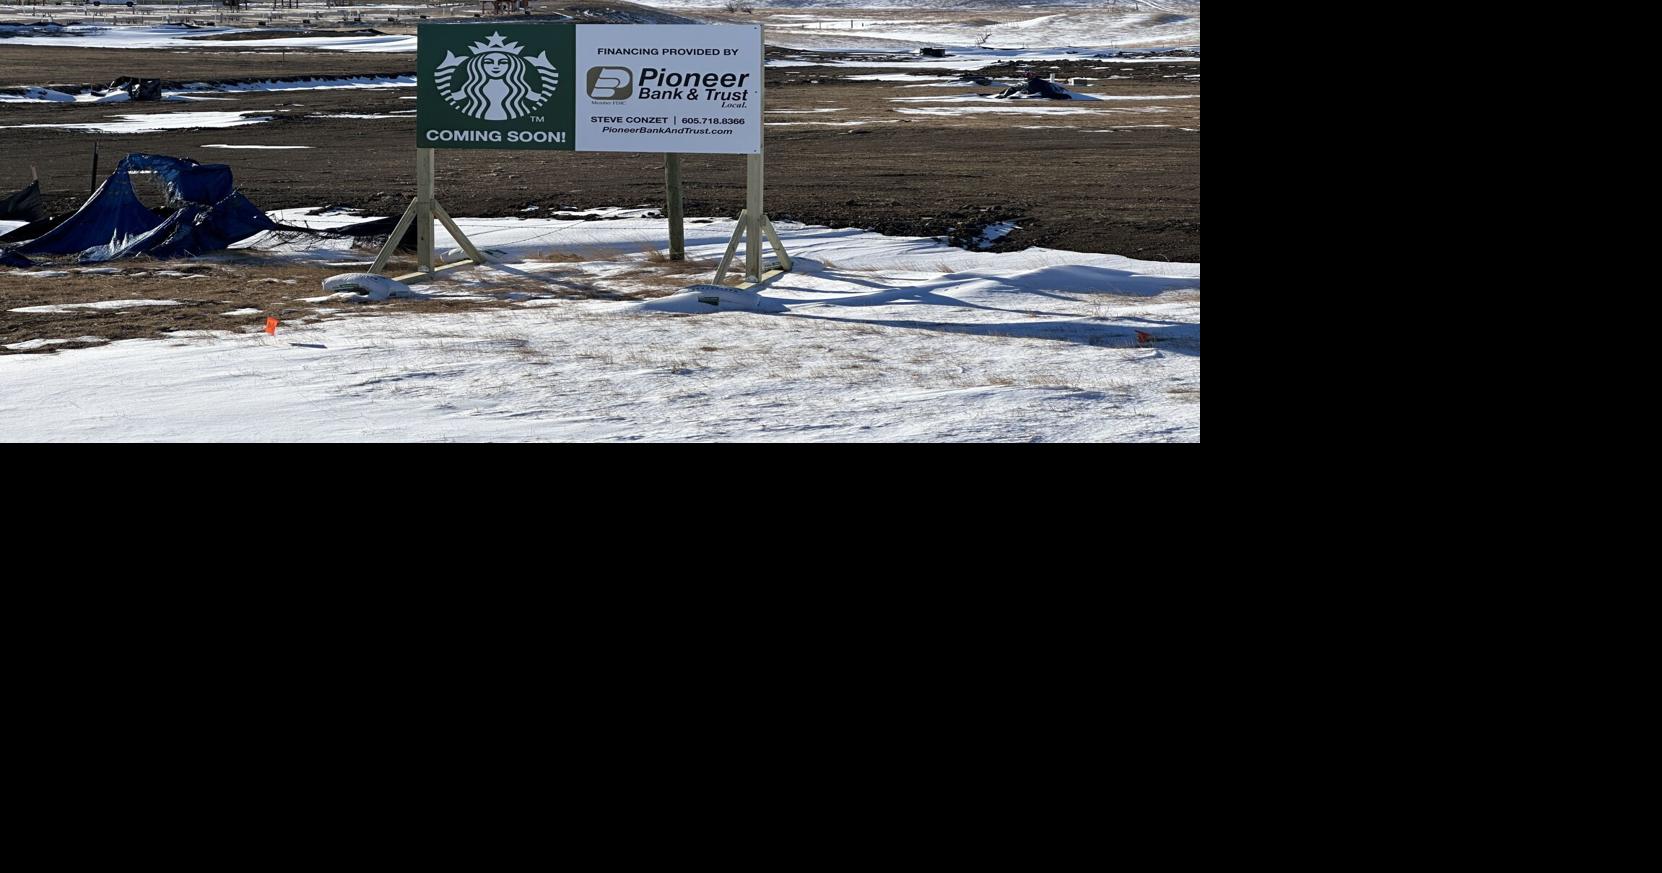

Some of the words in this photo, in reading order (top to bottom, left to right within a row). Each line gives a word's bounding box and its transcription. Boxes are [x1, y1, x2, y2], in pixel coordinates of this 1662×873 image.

[597, 47, 659, 56] FINANCING
[662, 48, 720, 56] PROVIDED
[723, 48, 739, 56] BY
[638, 67, 750, 88] Pioneer
[638, 87, 683, 100] Bank
[686, 88, 699, 101] &
[705, 88, 749, 101] Trust
[721, 101, 747, 109] Local.
[530, 115, 545, 123] TM
[590, 116, 623, 124] STEVE
[625, 116, 669, 124] CONZET
[681, 117, 745, 125] 605.718.8366
[601, 126, 733, 135] PioneerBankAndTrust.com
[426, 129, 502, 142] COMING
[507, 131, 566, 143] SOON!
